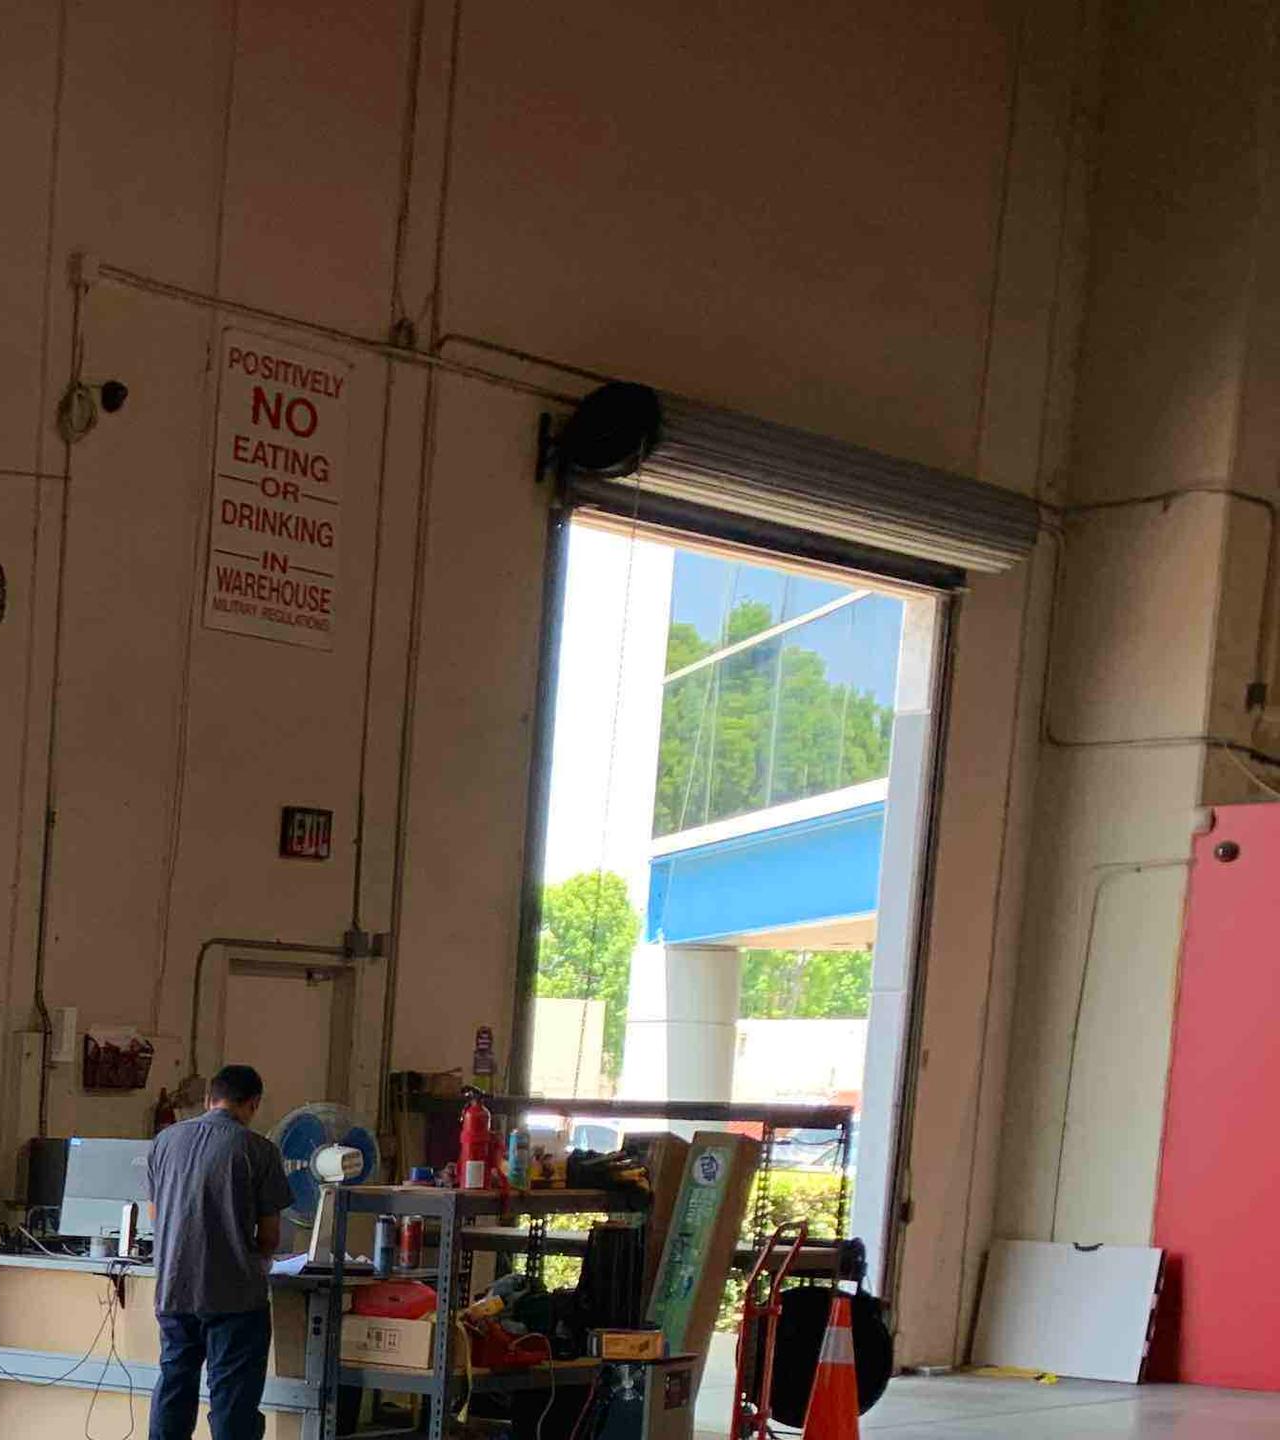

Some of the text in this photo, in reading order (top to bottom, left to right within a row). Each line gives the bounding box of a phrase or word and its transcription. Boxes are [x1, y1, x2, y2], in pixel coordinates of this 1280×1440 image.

[228, 346, 344, 399] POSITIVELY
[251, 385, 318, 438] NO
[233, 434, 330, 482] EATING
[261, 476, 300, 503] OR
[221, 499, 334, 548] DRINKING
[261, 551, 289, 574] IN
[216, 565, 333, 614] WAREHOUSE
[292, 812, 329, 857] EXIT
